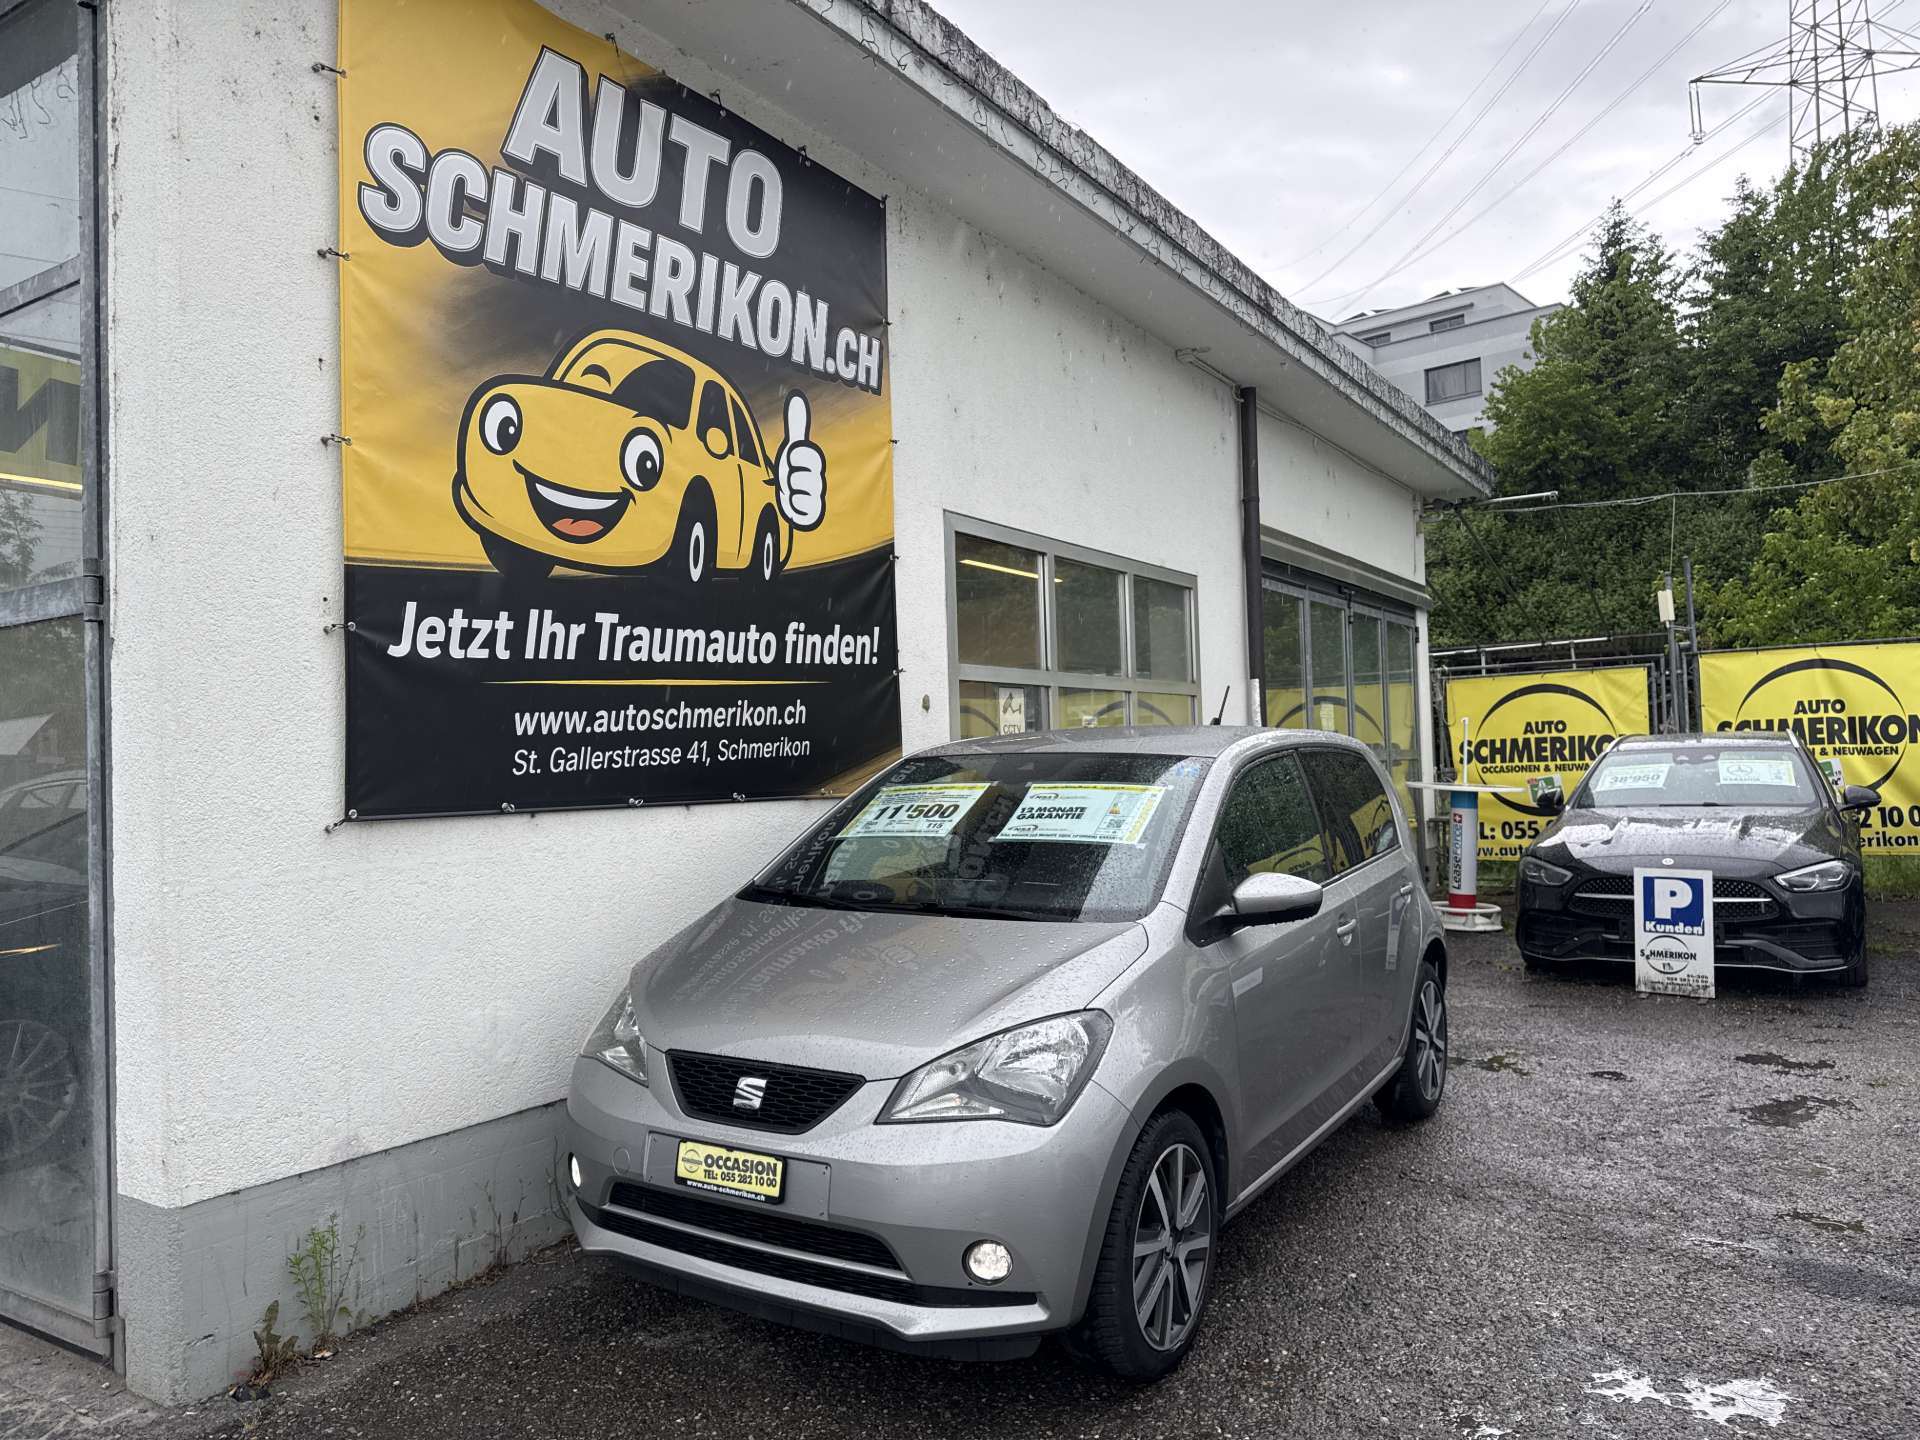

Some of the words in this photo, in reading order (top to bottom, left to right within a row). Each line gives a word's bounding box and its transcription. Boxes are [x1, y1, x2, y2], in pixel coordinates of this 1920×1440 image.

[502, 45, 783, 259] AUTO
[360, 123, 882, 390] SCHMERIKON.CH
[388, 601, 514, 659] Jetzt
[525, 608, 586, 660] Ihr
[595, 612, 777, 664] Traumauto
[784, 622, 880, 664] finden!
[1793, 699, 1846, 714] AUTO
[514, 700, 807, 736] www.autoschmerikon.ch
[1523, 720, 1567, 734] AUTO
[1003, 724, 1021, 735] CCTV
[512, 750, 542, 776] St.
[549, 741, 682, 774] Gallerstrasse
[687, 740, 711, 767] 41,
[718, 737, 810, 763] Schmerikon
[1459, 734, 1619, 765] SCHMERIKO
[1820, 747, 1829, 756] &
[1833, 746, 1899, 756] NEUWAGEN
[1481, 764, 1540, 774] OCCASIONEN
[1544, 764, 1551, 772] &
[874, 803, 960, 820] 11'500
[1016, 812, 1086, 820] GARANTIE
[1878, 806, 1904, 828] 10
[1501, 820, 1540, 840] 055
[1653, 878, 1693, 920] P
[1645, 920, 1703, 935] Kunden
[704, 1154, 777, 1178] OCCASION
[704, 1169, 718, 1180] TEL:
[720, 1171, 735, 1182] 055
[737, 1173, 752, 1185] 282
[755, 1175, 765, 1187] 10
[766, 1177, 777, 1188] 00
